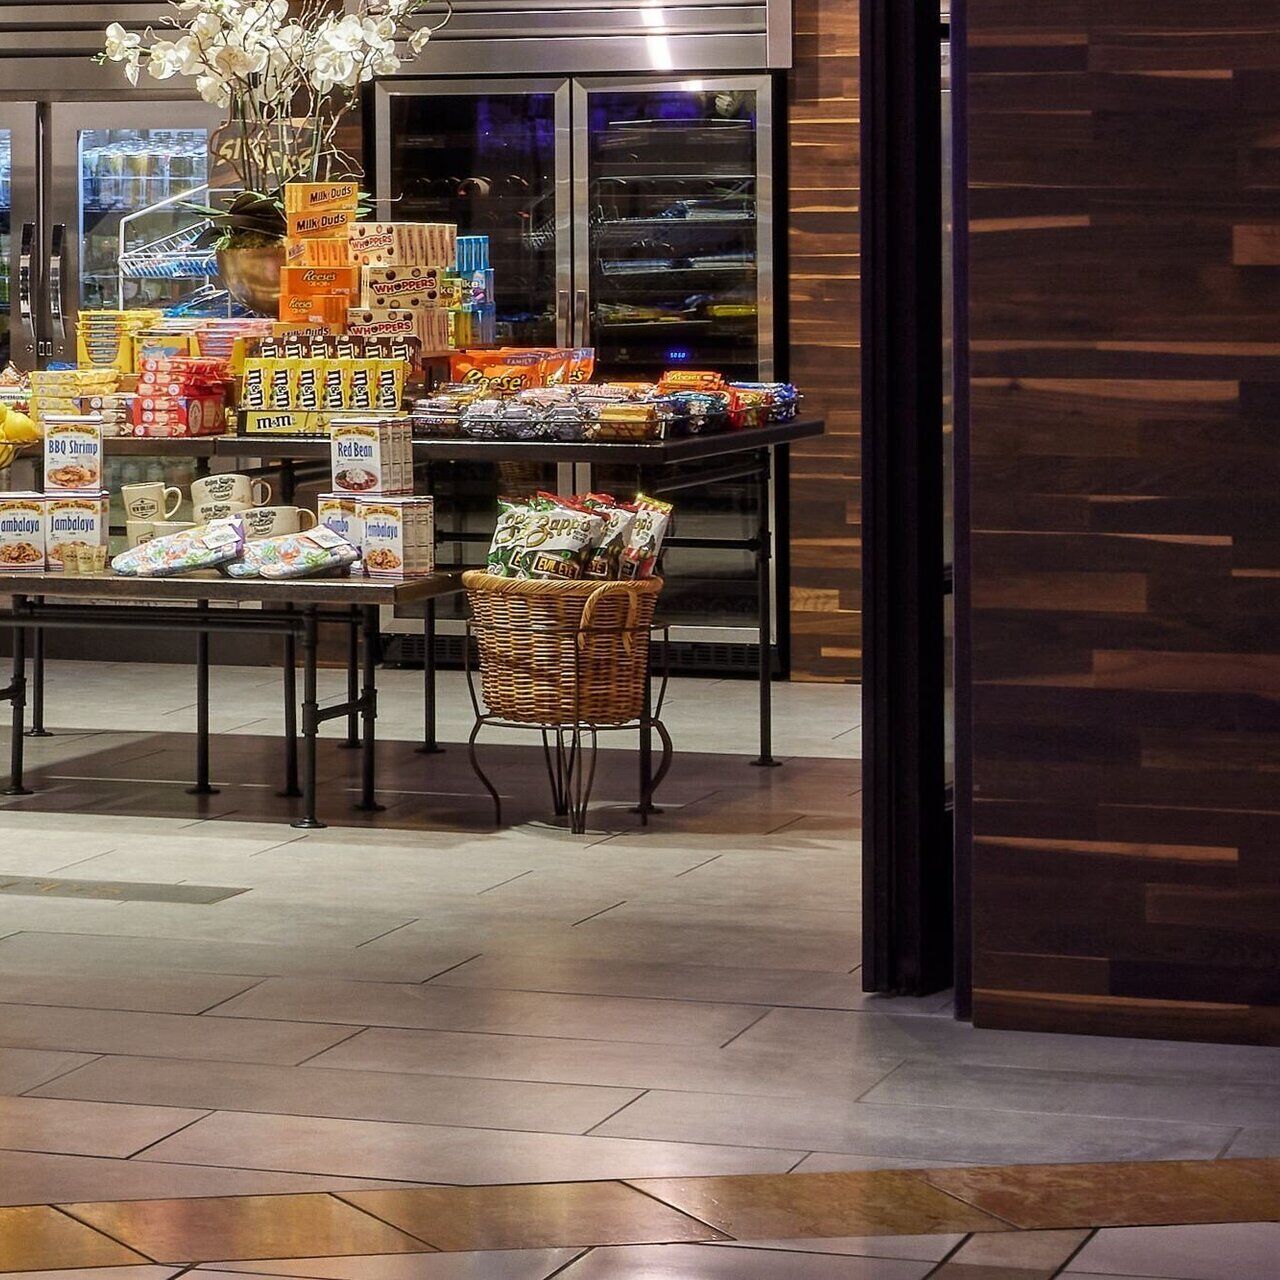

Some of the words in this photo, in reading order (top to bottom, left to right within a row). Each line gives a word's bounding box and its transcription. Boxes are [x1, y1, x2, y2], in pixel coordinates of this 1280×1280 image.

[309, 191, 329, 205] Milk
[330, 185, 353, 199] Duds
[296, 219, 319, 234] Milk
[321, 214, 346, 227] Duds
[351, 234, 393, 250] WHOPPERS
[374, 278, 436, 295] WHOPPERS
[352, 321, 412, 336] WHOPPERS
[48, 440, 66, 455] BBQ
[69, 440, 98, 456] Shrimp
[338, 442, 352, 457] Red
[354, 443, 373, 458] Bean
[50, 516, 95, 533] Jambalaya
[365, 521, 398, 540] Jambalaya
[539, 558, 557, 571] EVIL
[558, 562, 575, 576] EYE
